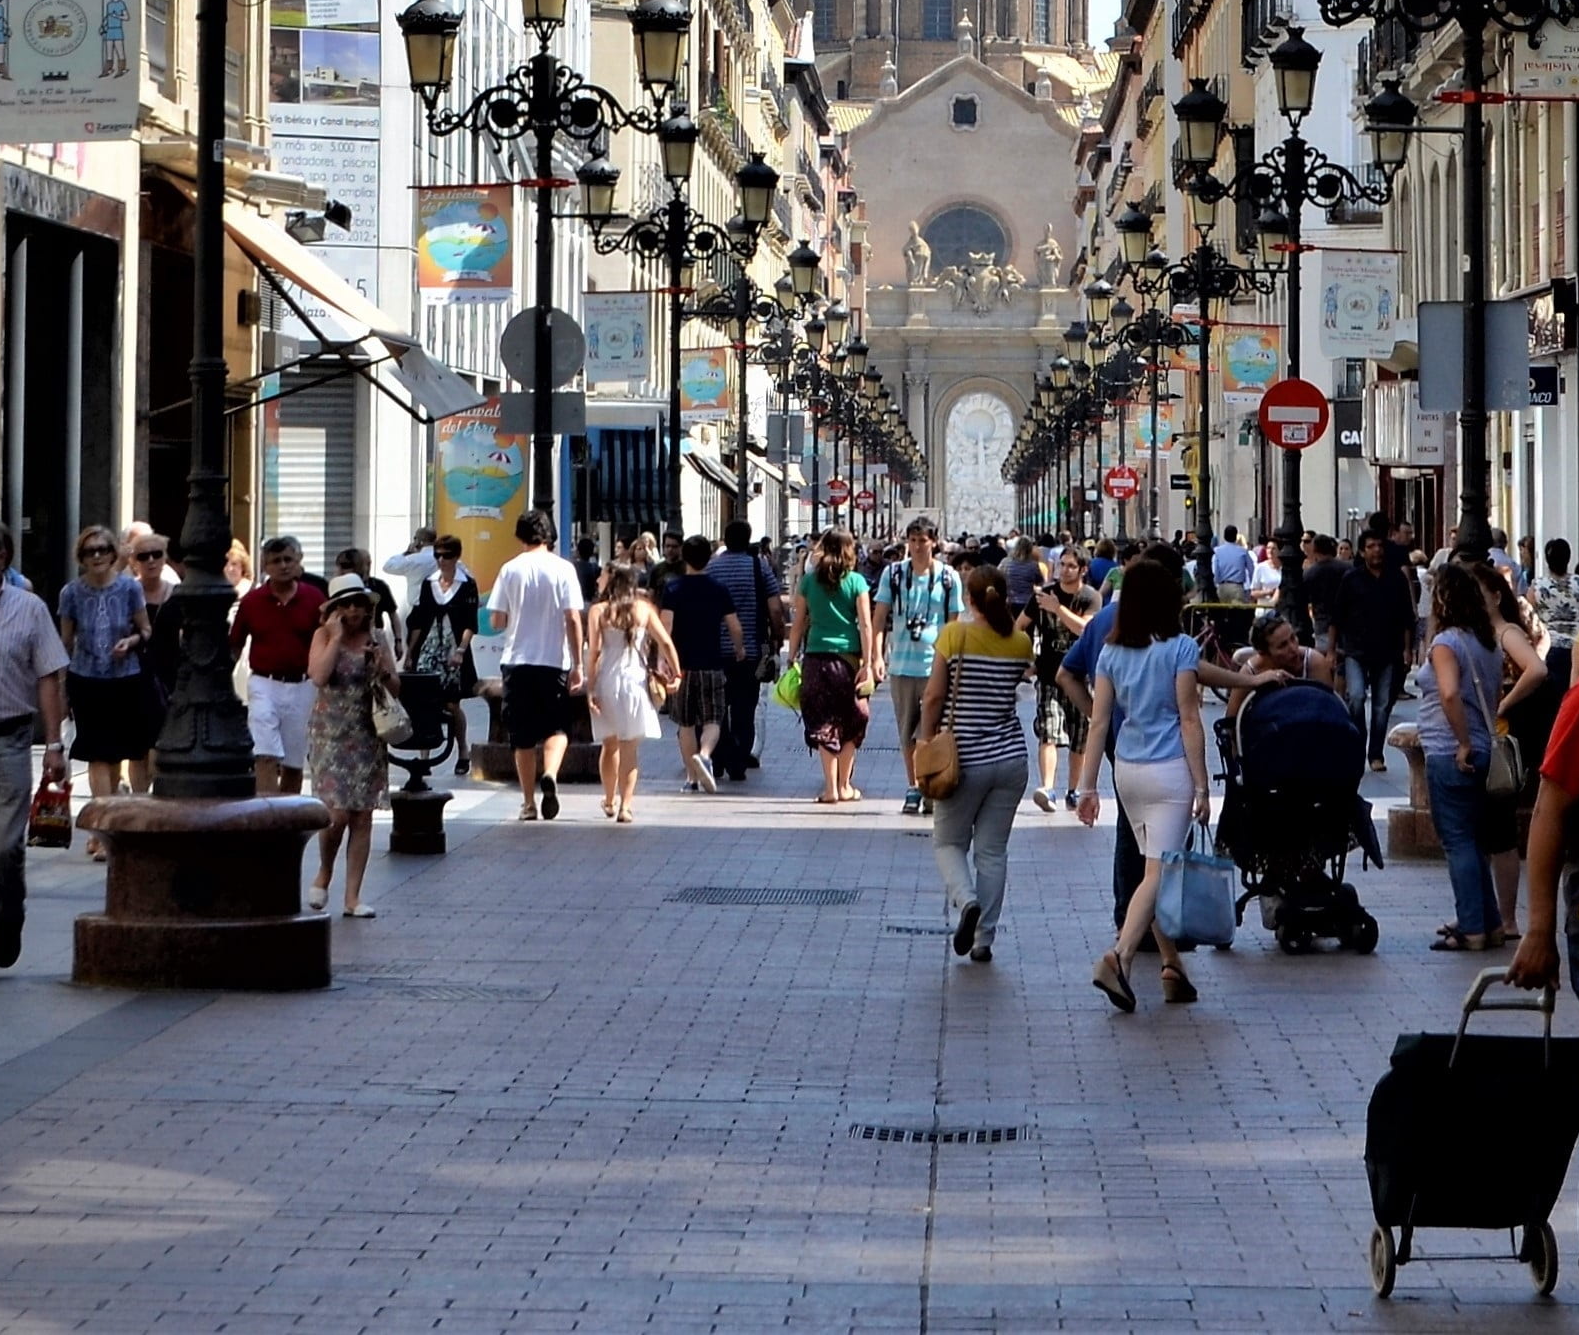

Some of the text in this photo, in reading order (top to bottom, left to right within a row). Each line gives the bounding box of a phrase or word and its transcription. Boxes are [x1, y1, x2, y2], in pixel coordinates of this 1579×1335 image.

[96, 123, 132, 132] Zaragoza
[320, 116, 343, 127] Canal
[309, 140, 323, 152] de
[330, 142, 355, 154] 5.000
[342, 157, 376, 172] piscina
[332, 172, 355, 185] pista
[363, 173, 376, 184] de
[338, 186, 376, 201] amplias
[442, 419, 498, 438] del Ebro
